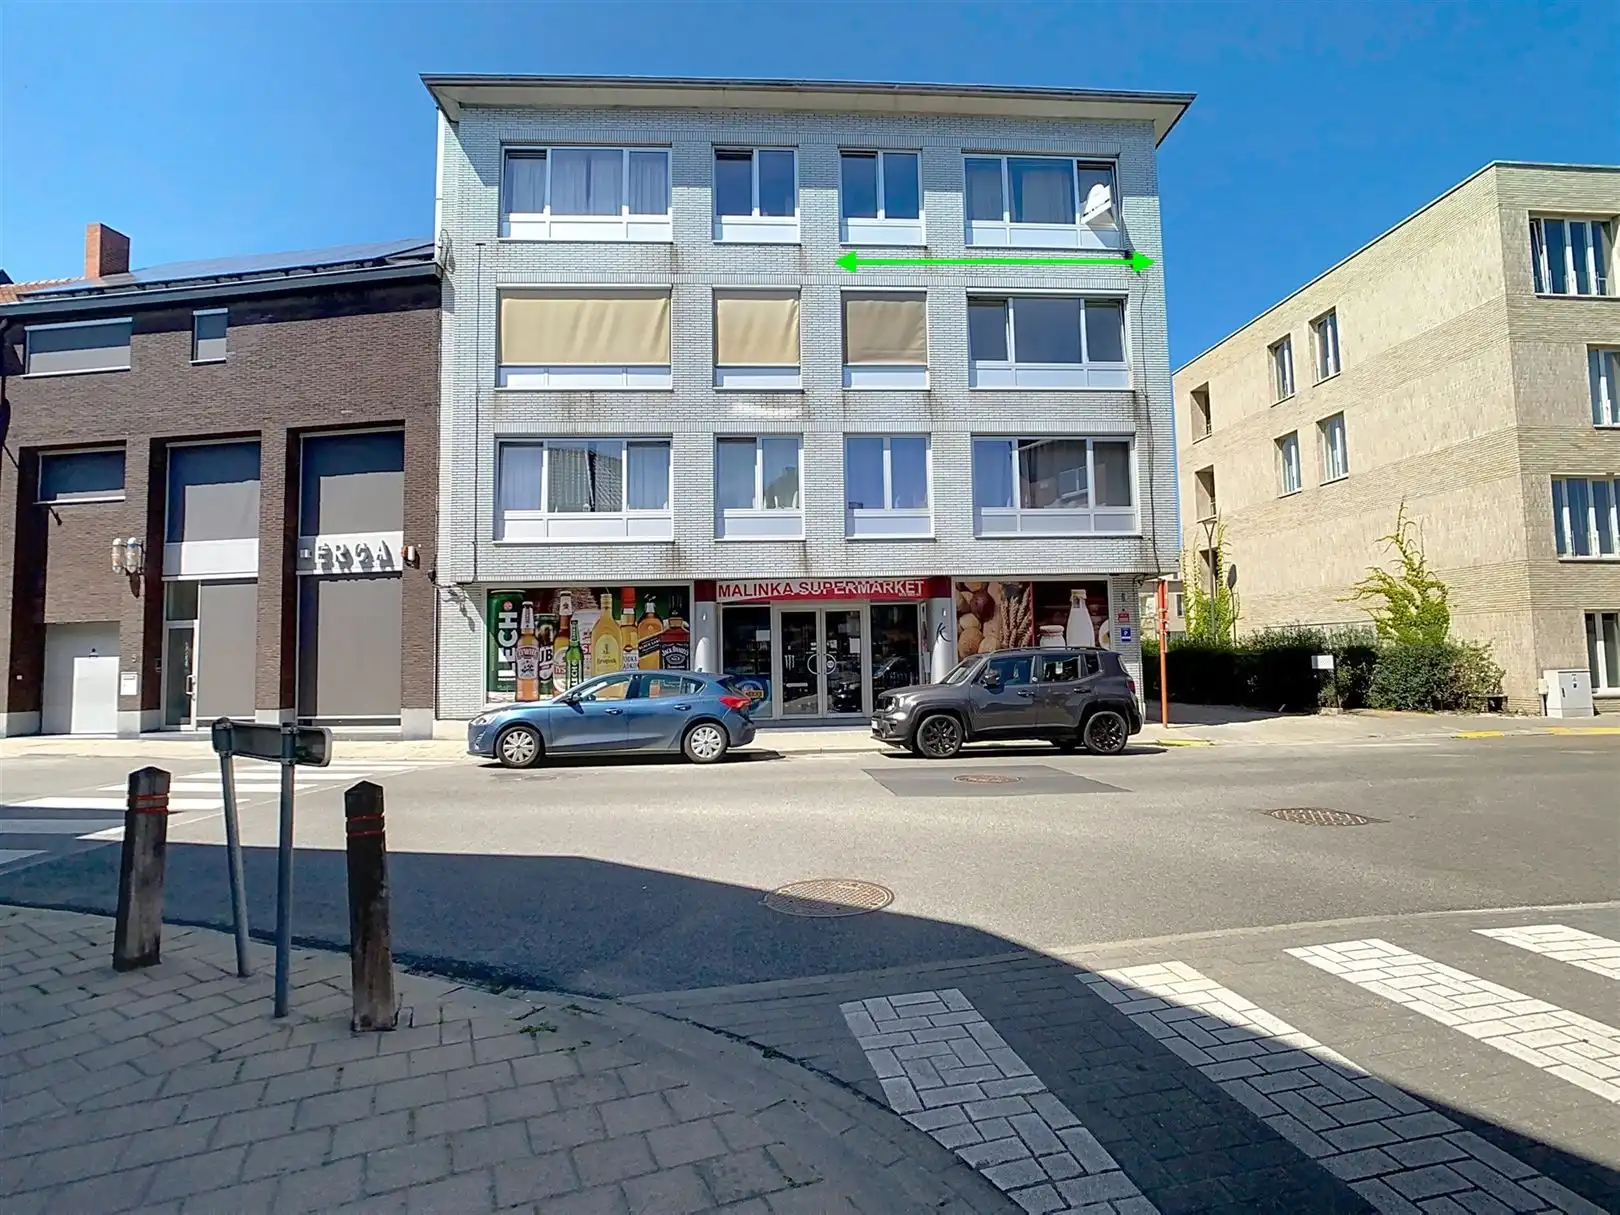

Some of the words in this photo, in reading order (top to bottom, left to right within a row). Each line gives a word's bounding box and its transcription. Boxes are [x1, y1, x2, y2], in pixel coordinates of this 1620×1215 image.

[718, 581, 793, 598] MALINKA
[798, 580, 925, 595] SUPERMARKET
[498, 612, 518, 677] LECH
